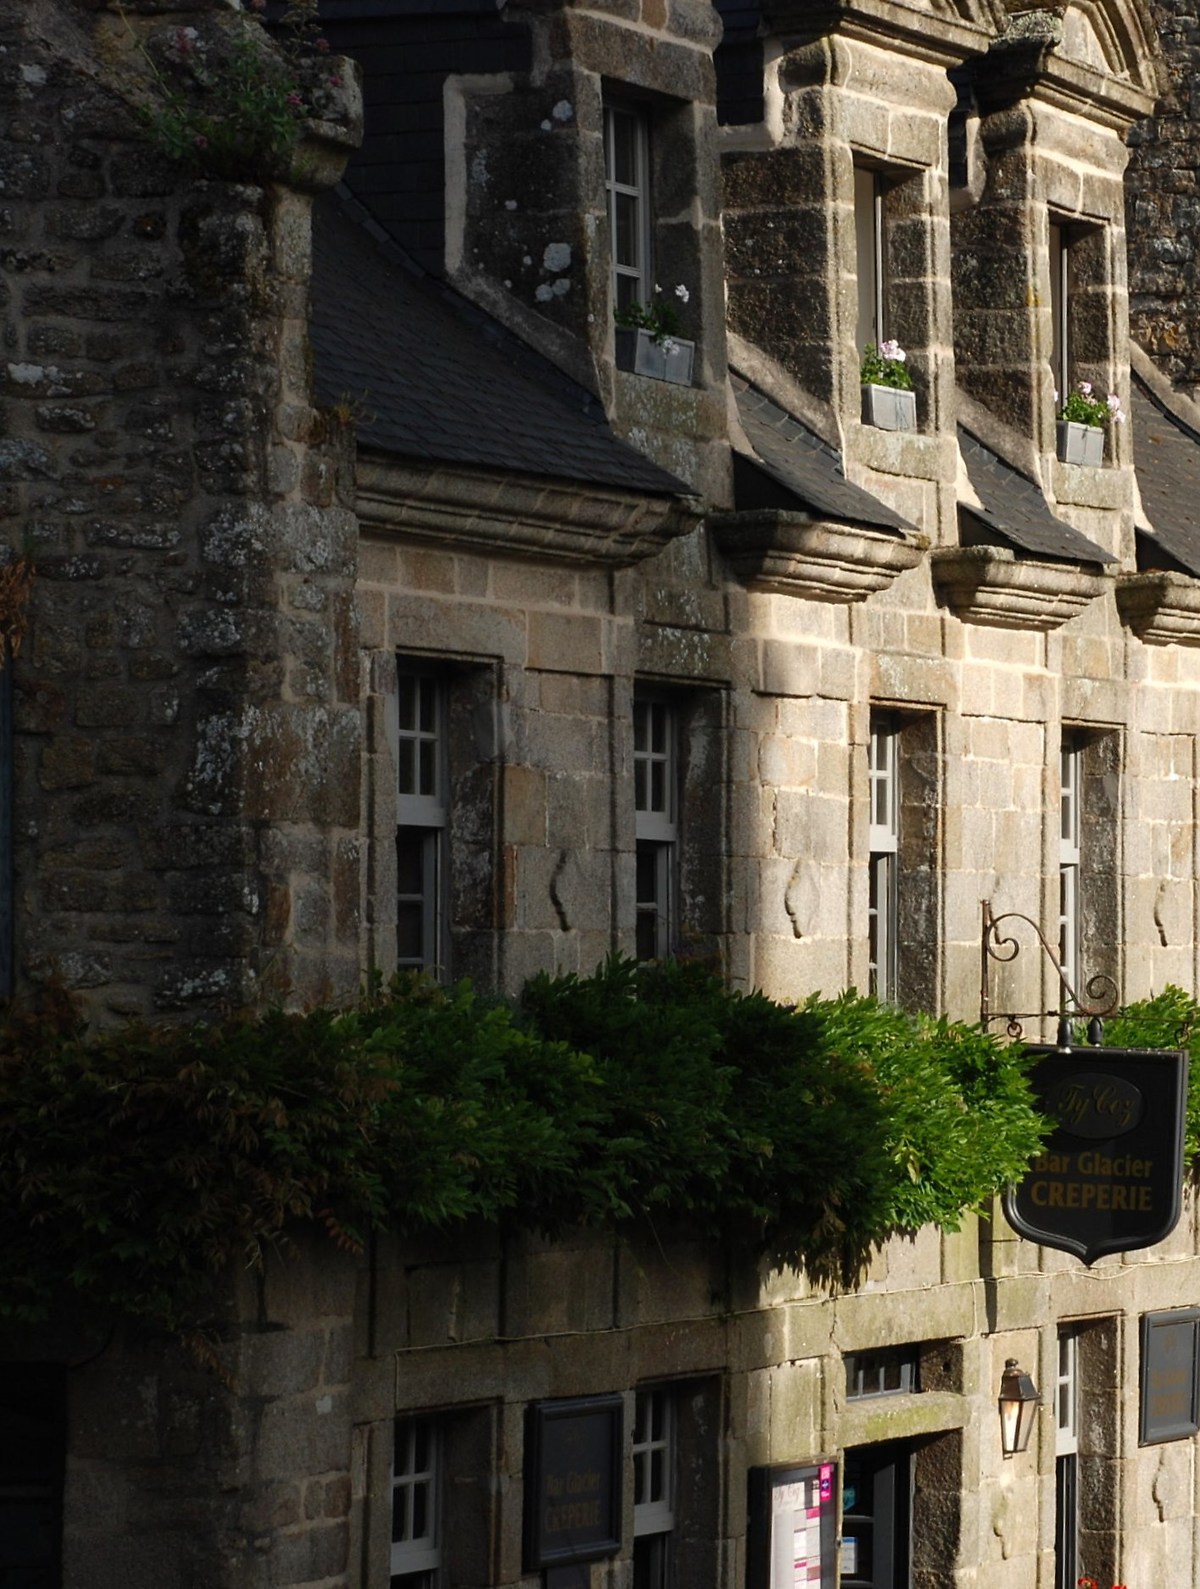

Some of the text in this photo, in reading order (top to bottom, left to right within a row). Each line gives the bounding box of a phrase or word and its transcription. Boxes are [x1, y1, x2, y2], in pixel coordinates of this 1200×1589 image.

[1034, 1151, 1153, 1178] Bar Glacier
[1030, 1180, 1153, 1211] CREPERIE
